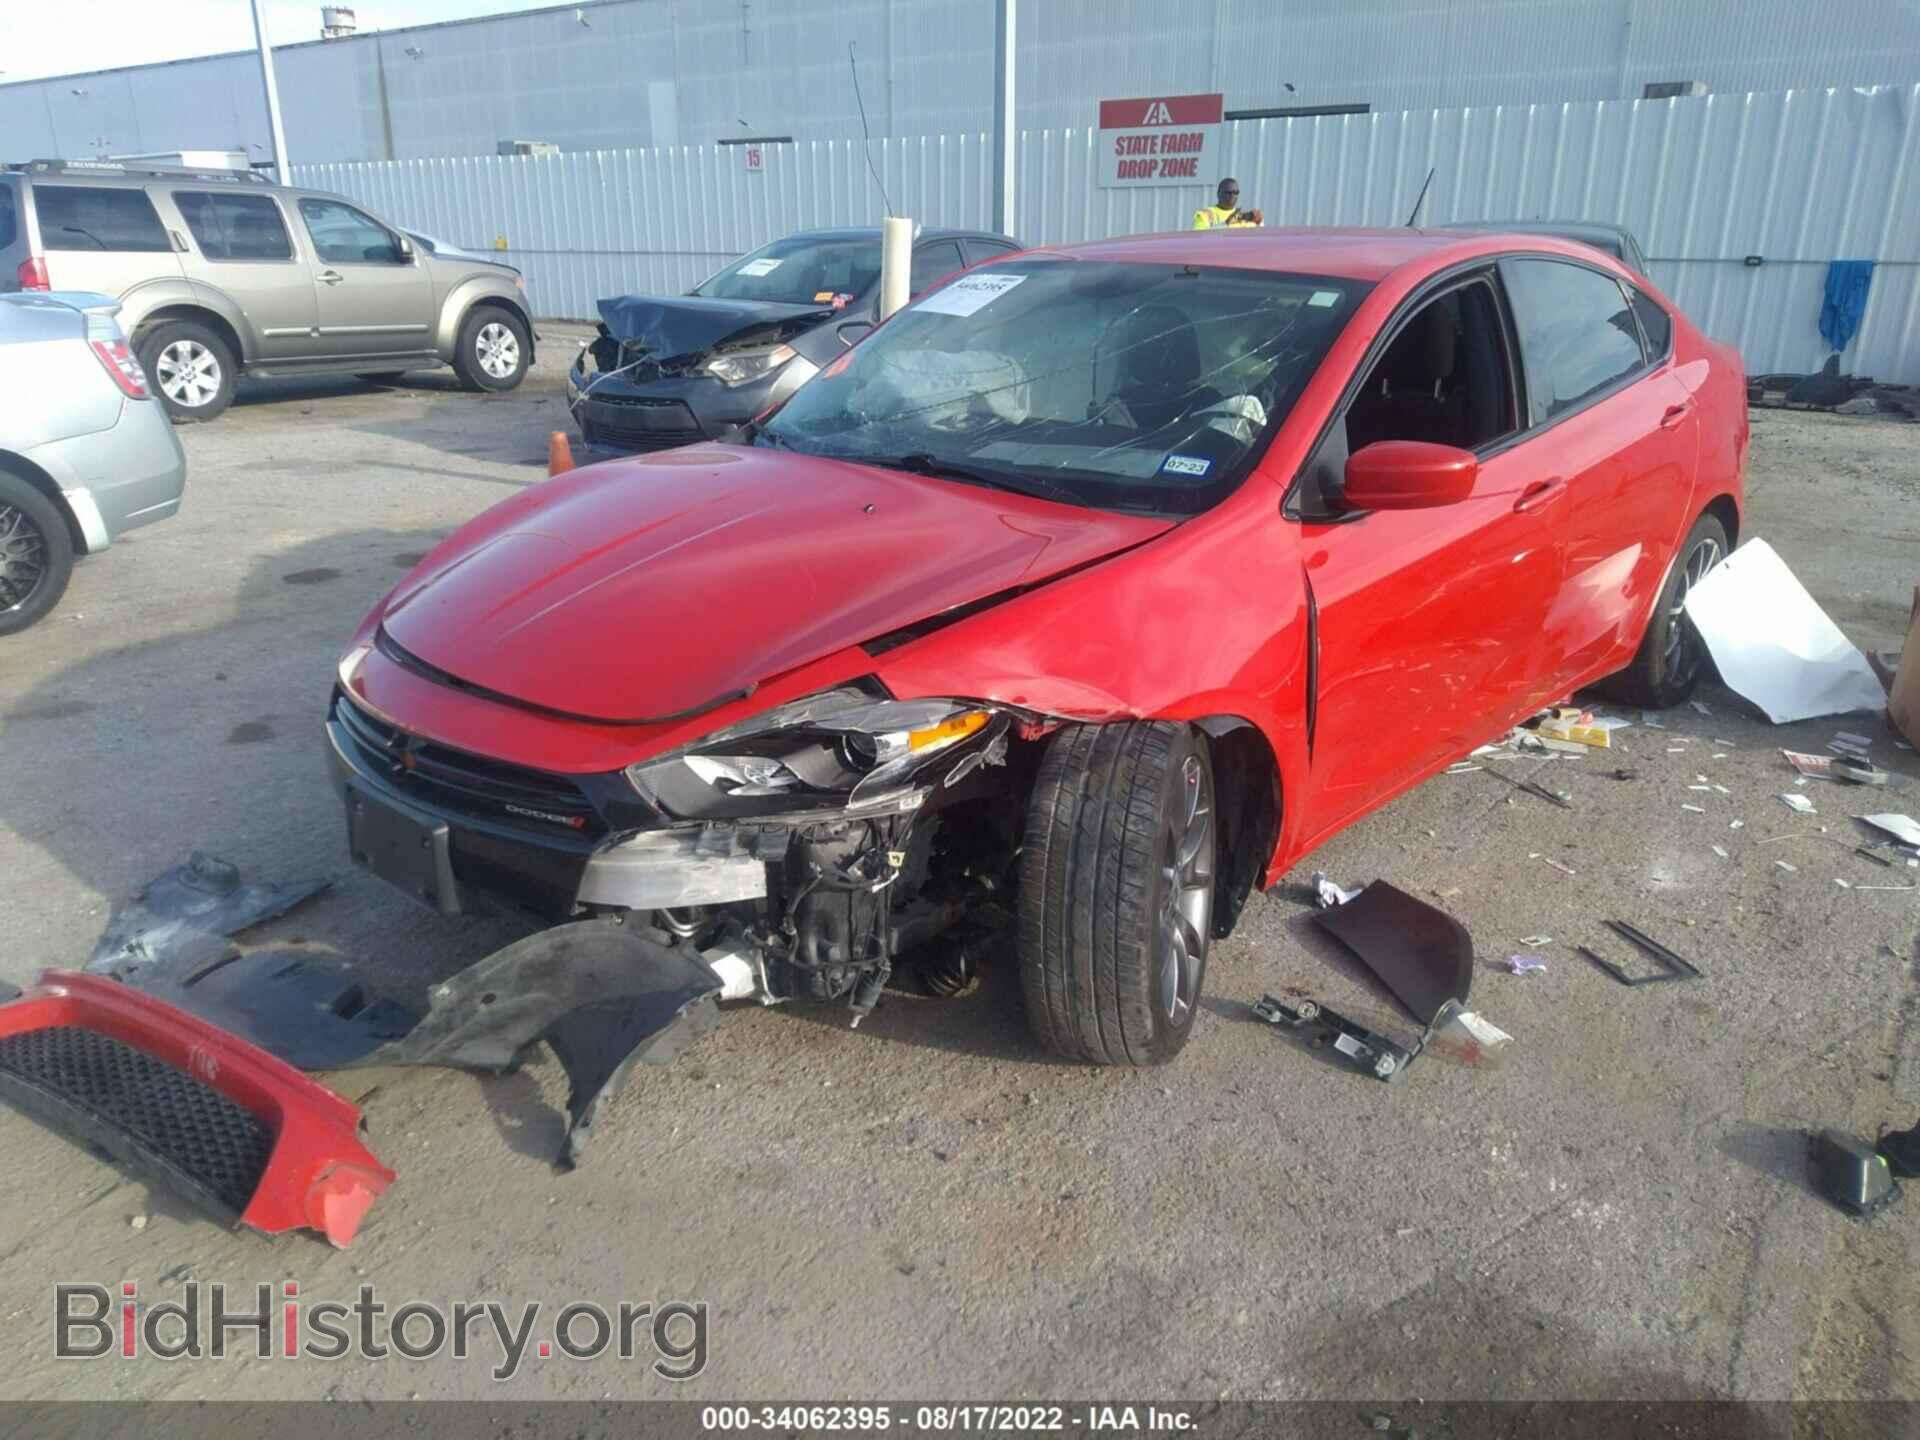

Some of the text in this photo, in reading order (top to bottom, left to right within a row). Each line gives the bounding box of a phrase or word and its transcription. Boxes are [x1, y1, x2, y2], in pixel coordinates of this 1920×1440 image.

[1115, 132, 1204, 156] STATE FARM
[748, 149, 760, 167] 15
[1117, 157, 1199, 179] DROP ZONE
